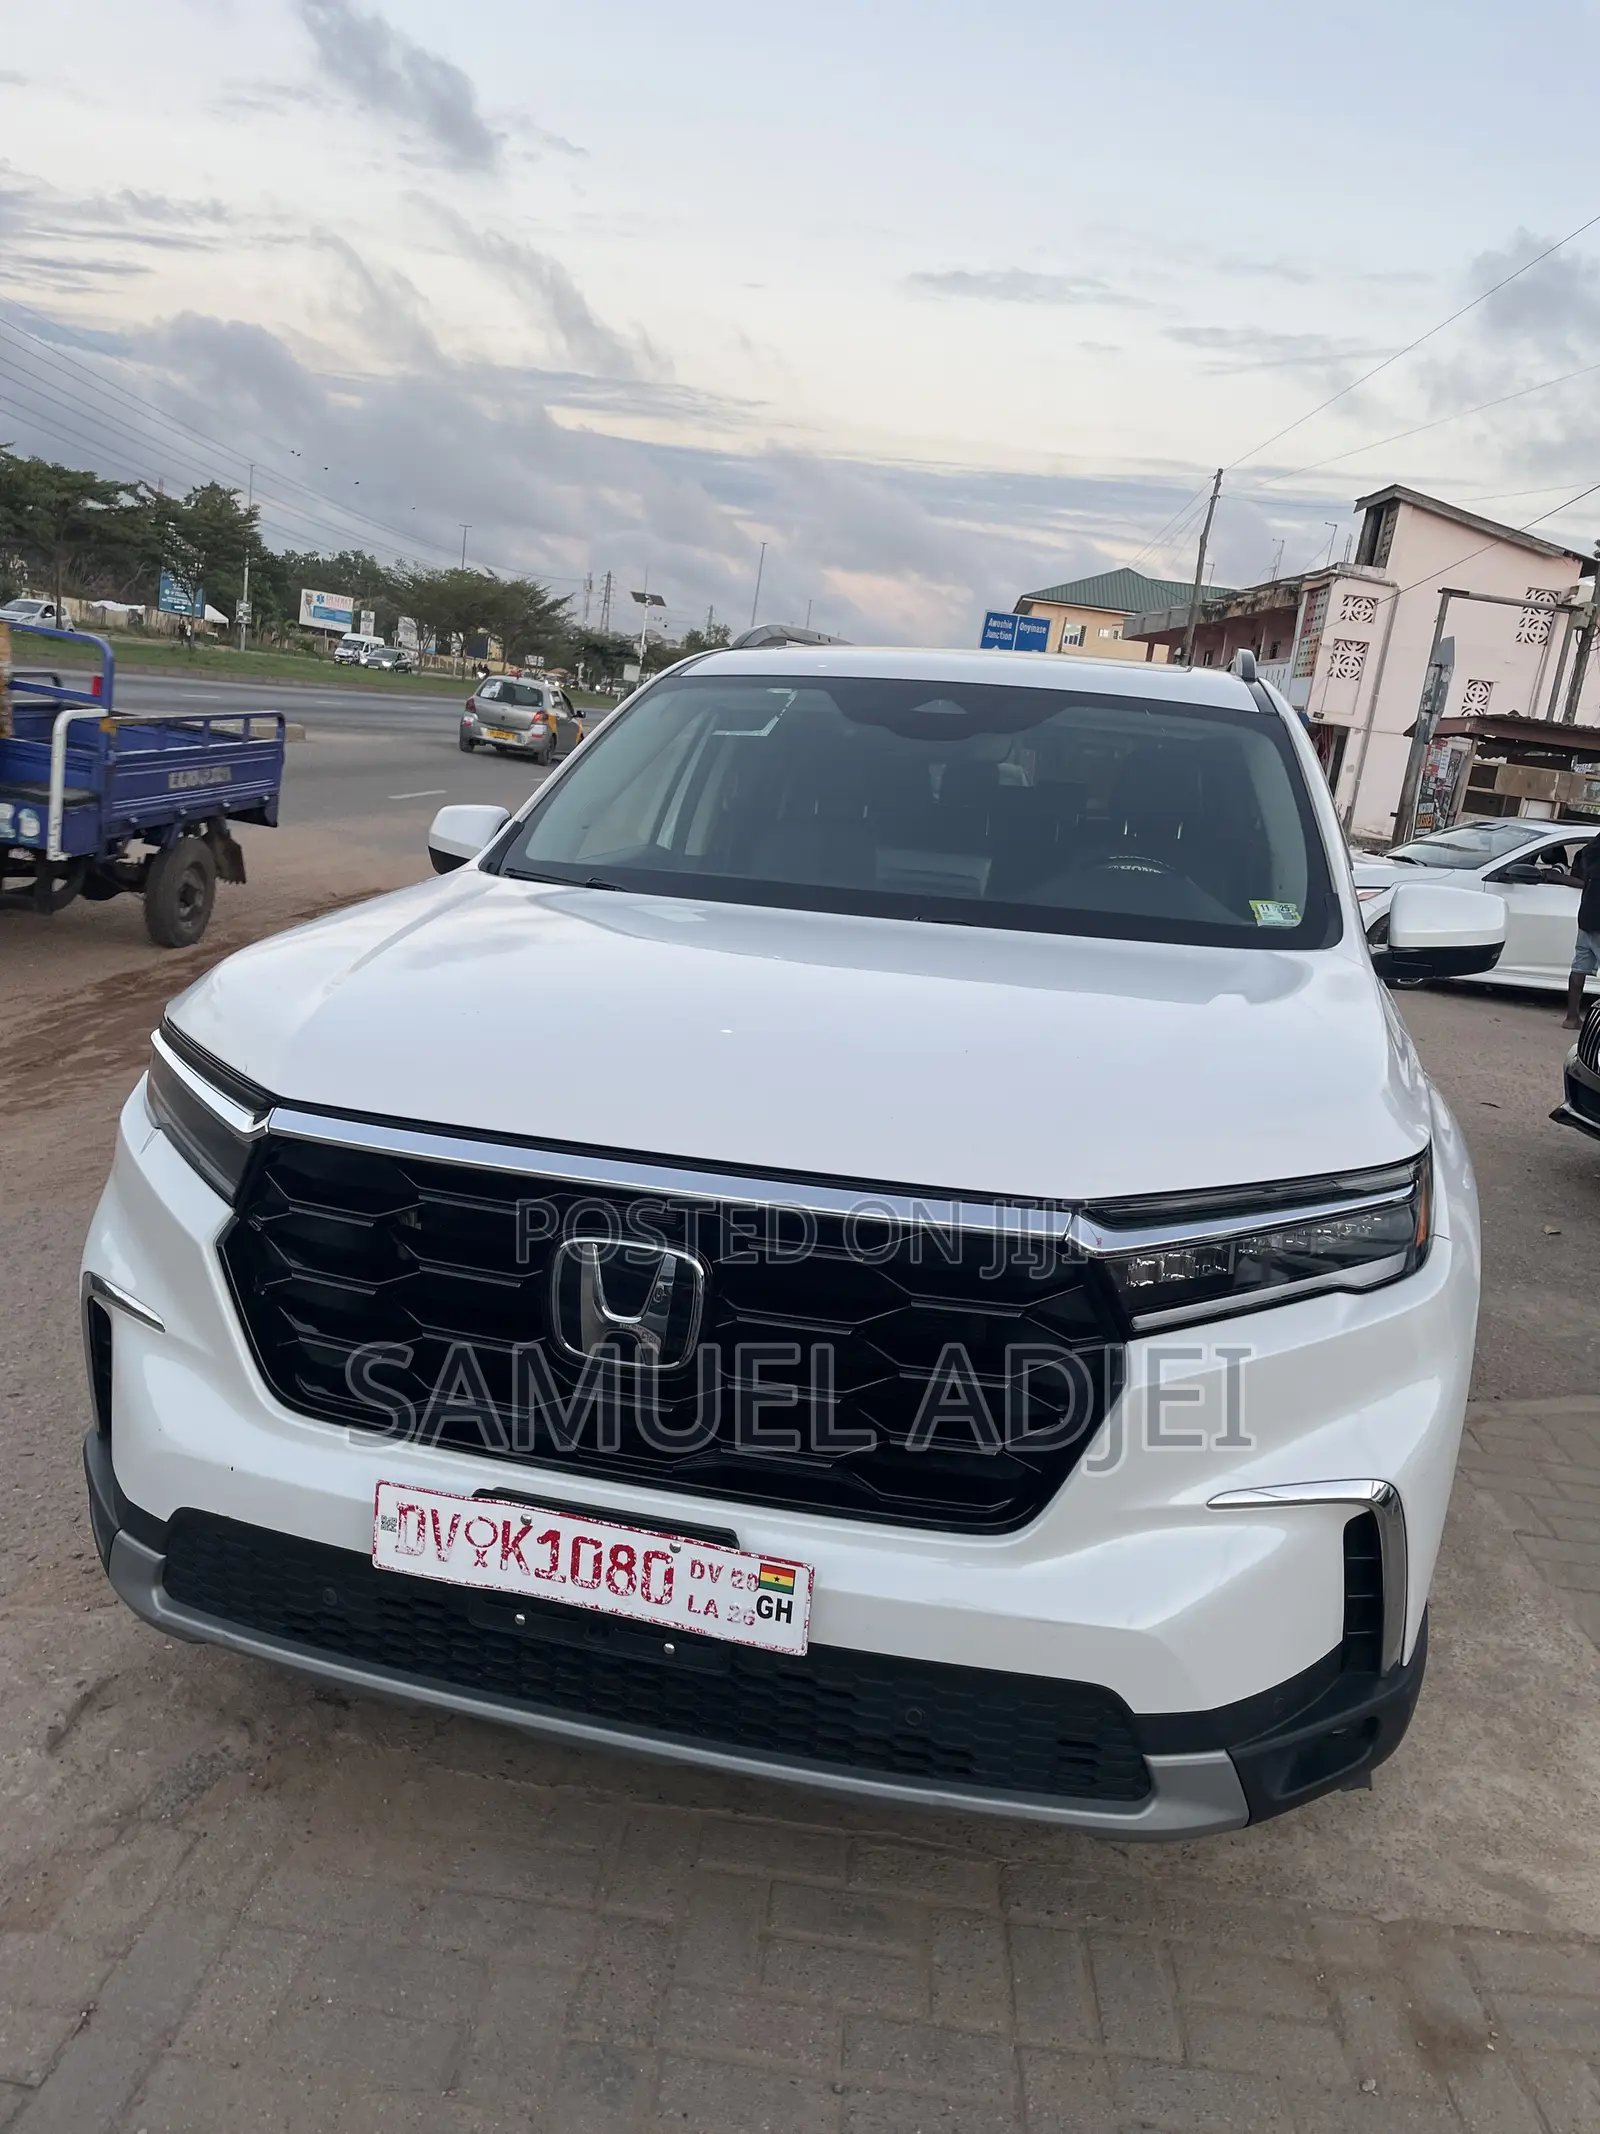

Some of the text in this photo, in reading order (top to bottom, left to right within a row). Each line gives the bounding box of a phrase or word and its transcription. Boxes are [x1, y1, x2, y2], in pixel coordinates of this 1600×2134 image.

[985, 629, 1012, 641] Junction
[988, 617, 1013, 629] Awoshie
[690, 1558, 725, 1584] DV
[687, 1594, 720, 1619] LA
[756, 1594, 794, 1625] GH
